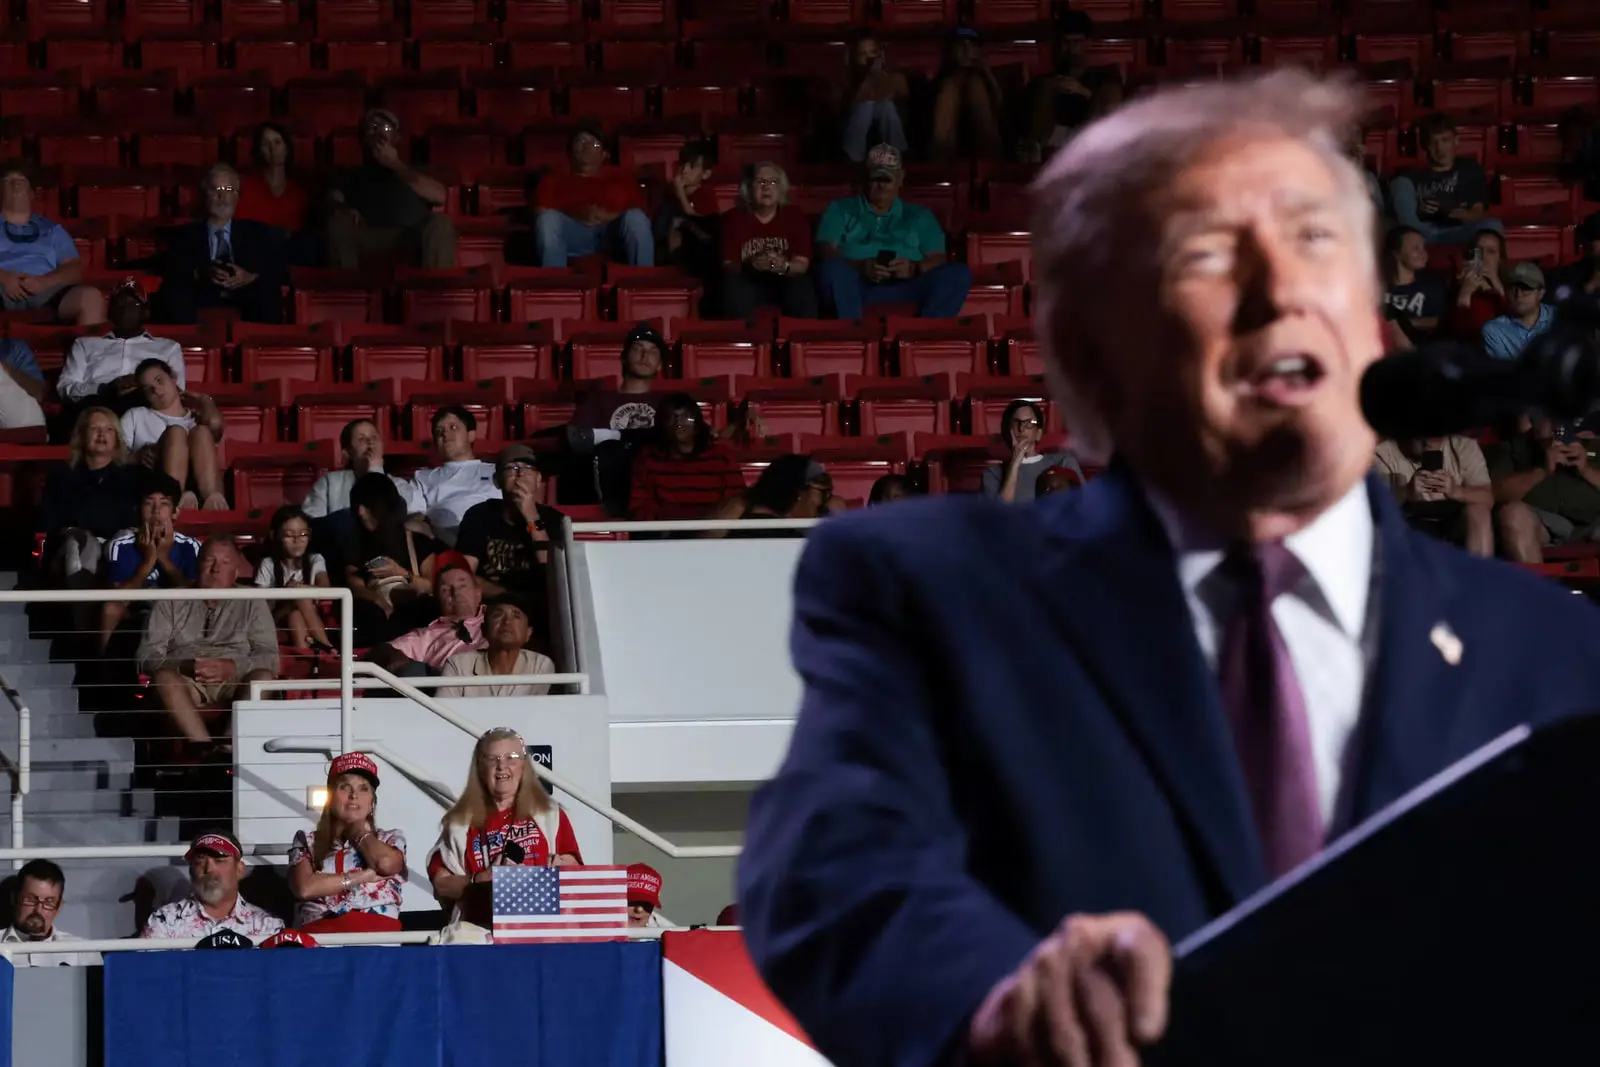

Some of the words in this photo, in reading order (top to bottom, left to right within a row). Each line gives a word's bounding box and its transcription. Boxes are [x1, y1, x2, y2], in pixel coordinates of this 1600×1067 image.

[532, 753, 551, 764] ON
[211, 935, 241, 947] USA
[274, 933, 303, 945] USA
